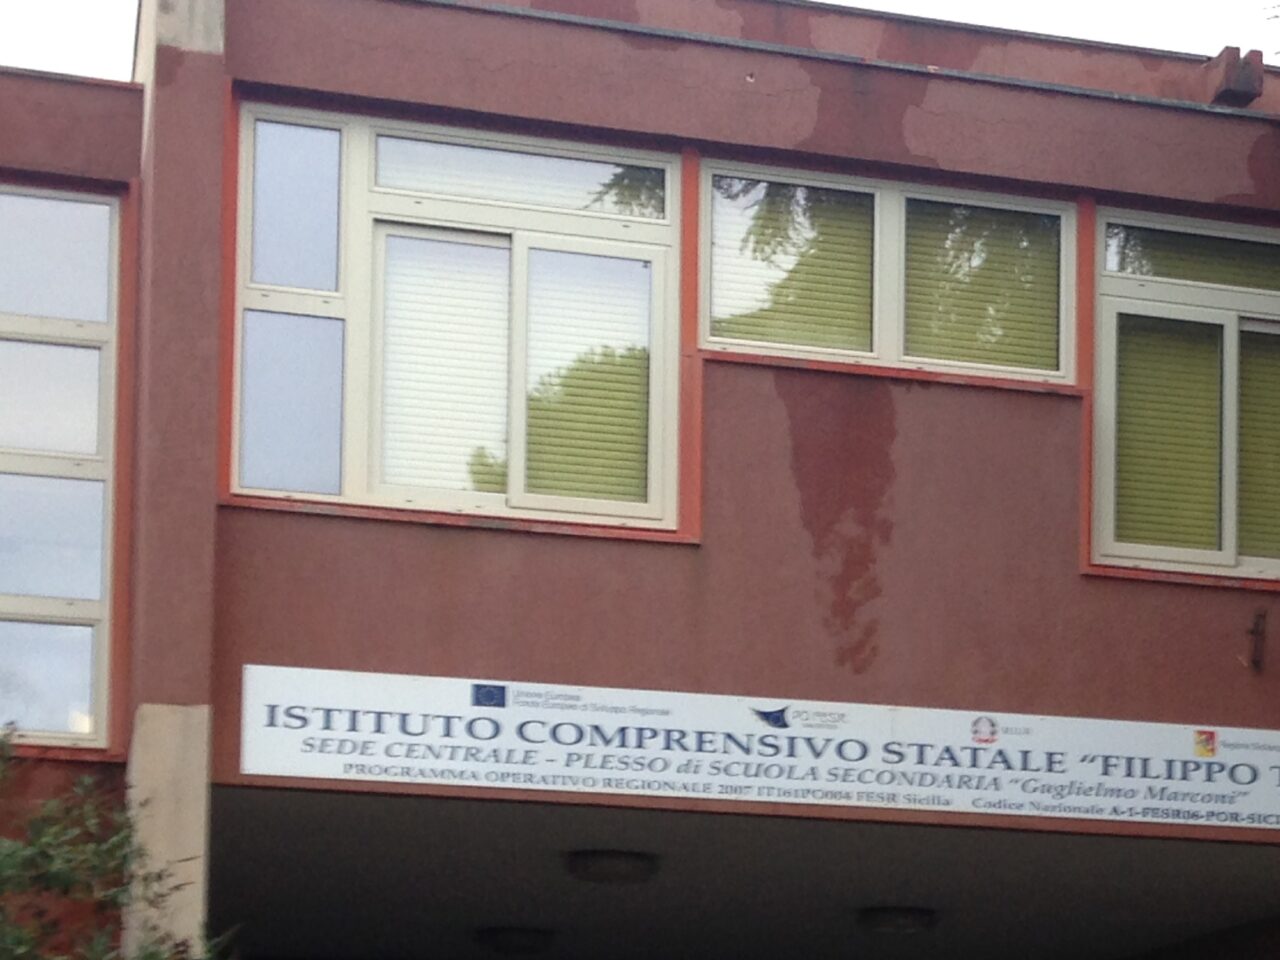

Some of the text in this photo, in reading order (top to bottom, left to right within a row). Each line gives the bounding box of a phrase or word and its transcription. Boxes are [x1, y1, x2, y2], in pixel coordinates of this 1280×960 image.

[263, 704, 502, 741] ISTITUTO
[515, 719, 869, 763] COMPRENSIVO
[882, 741, 1066, 774] STATALE
[300, 737, 377, 758] SEDE
[383, 741, 538, 766] CENTRALE
[563, 751, 670, 774] PLESSO
[676, 758, 701, 775] di
[707, 759, 818, 782] SCUOLA
[826, 765, 1001, 792] SECONDARIA
[342, 763, 479, 782] PROGRAMMA
[484, 770, 597, 788] OPERATIVO
[602, 777, 712, 795] REGIONALE
[717, 783, 752, 796] 2007
[856, 790, 898, 804] FESR
[902, 793, 951, 807] Sicilia
[971, 796, 1024, 811] Codice
[1029, 801, 1104, 817] Nazionale
